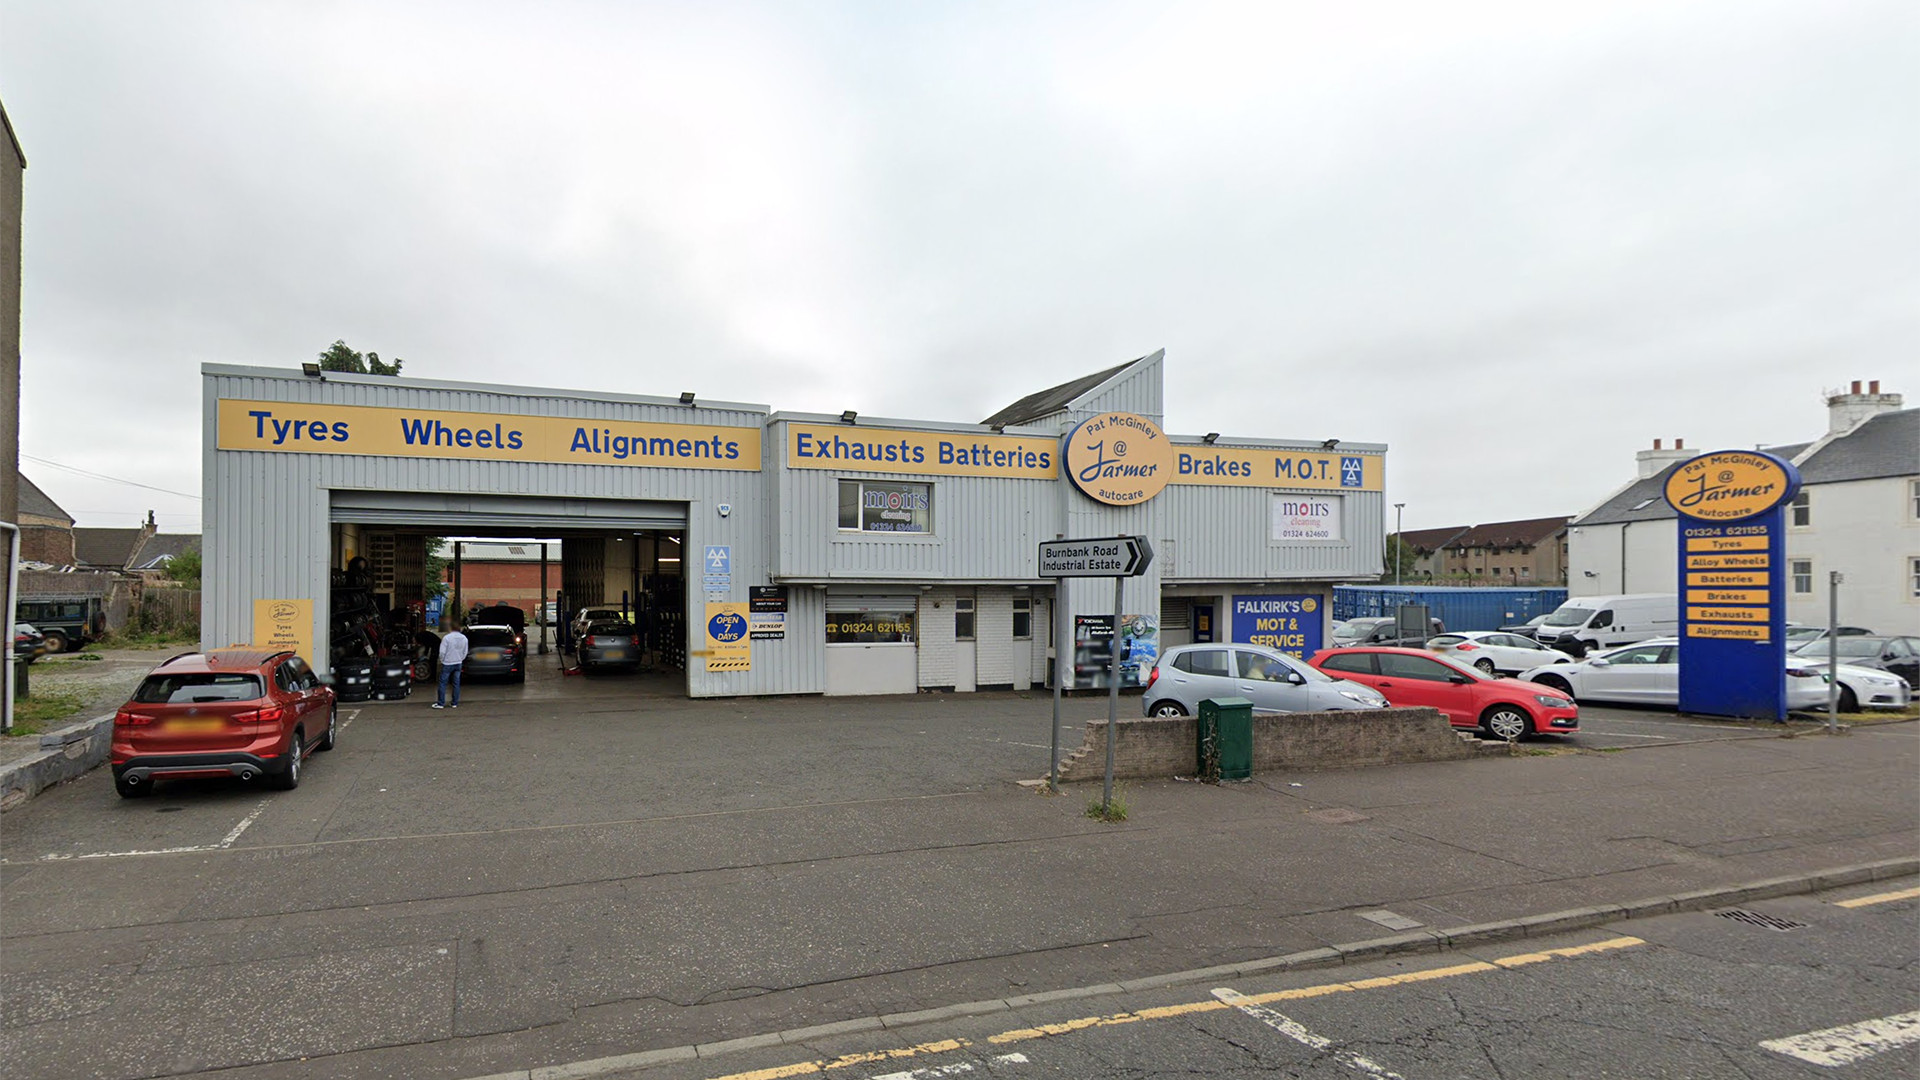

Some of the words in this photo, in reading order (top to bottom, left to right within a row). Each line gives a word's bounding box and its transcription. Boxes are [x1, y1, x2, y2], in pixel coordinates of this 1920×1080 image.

[1086, 420, 1105, 435] Pat
[1109, 416, 1157, 439] McGinley
[248, 410, 349, 445] Tyres
[400, 418, 523, 450] Wheels
[570, 427, 739, 460] Alignments
[796, 432, 925, 463] Exhausts
[938, 441, 1052, 469] Batteries
[1113, 440, 1127, 457] @
[1178, 453, 1252, 477] Brakes
[1274, 457, 1333, 480] M.O.T.
[1685, 462, 1706, 474] Pat
[1711, 455, 1771, 471] McGinley
[1718, 471, 1735, 483] @
[865, 485, 929, 510] moirs
[1099, 489, 1143, 500] autocare
[1283, 497, 1329, 517] moirs
[1697, 507, 1752, 517] autocare
[881, 510, 911, 521] cleaning
[1291, 518, 1320, 528] cleaning
[1305, 530, 1329, 538] 624600
[1685, 528, 1721, 537] 01324
[1726, 526, 1767, 536] 621155
[1712, 540, 1742, 549] Tyres
[1046, 547, 1089, 558] Burnbank
[1093, 545, 1118, 556] Road
[1043, 560, 1085, 571] Industrial
[1089, 559, 1121, 570] Estate
[1691, 559, 1719, 567] Alloy
[1724, 557, 1766, 565] Wheels
[1700, 575, 1753, 583] Batteries
[1707, 592, 1746, 601] Brakes
[1237, 601, 1300, 613] FALKIRK'S
[716, 616, 739, 624] OPEN
[1701, 610, 1753, 619] Exhausts
[724, 624, 732, 633] 7
[842, 624, 873, 632] 01324
[877, 623, 911, 632] 621155
[1256, 618, 1286, 631] MOT
[1288, 618, 1298, 631] &
[717, 633, 739, 641] DAYS
[1696, 627, 1759, 637] Alignments
[1250, 634, 1304, 647] SERVICE
